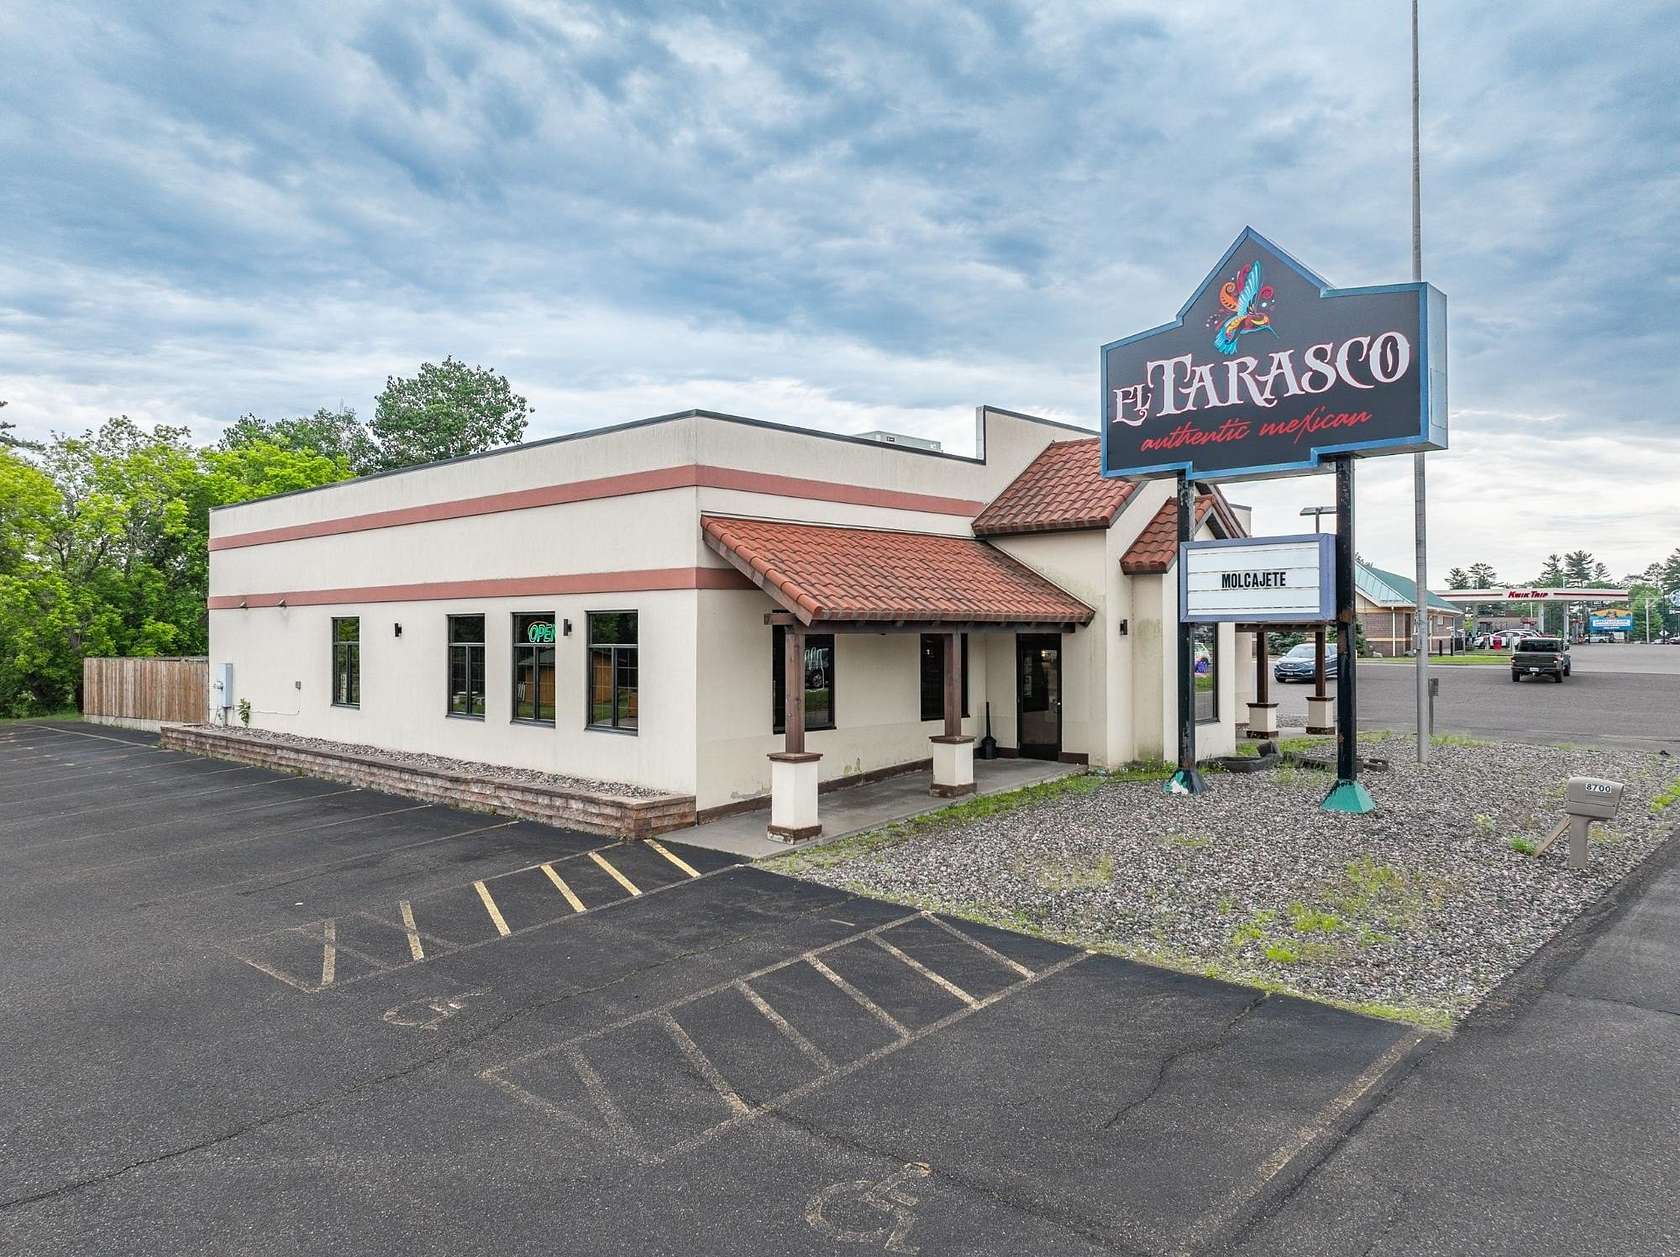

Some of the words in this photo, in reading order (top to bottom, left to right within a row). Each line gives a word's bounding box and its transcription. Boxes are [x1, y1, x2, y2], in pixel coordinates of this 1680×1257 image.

[1112, 383, 1153, 427] EL
[1146, 331, 1411, 417] TARASCO
[1140, 417, 1252, 452] authentic
[1259, 405, 1373, 444] mexican
[1221, 571, 1287, 589] MOLCAJETE
[1585, 783, 1611, 793] 8700
